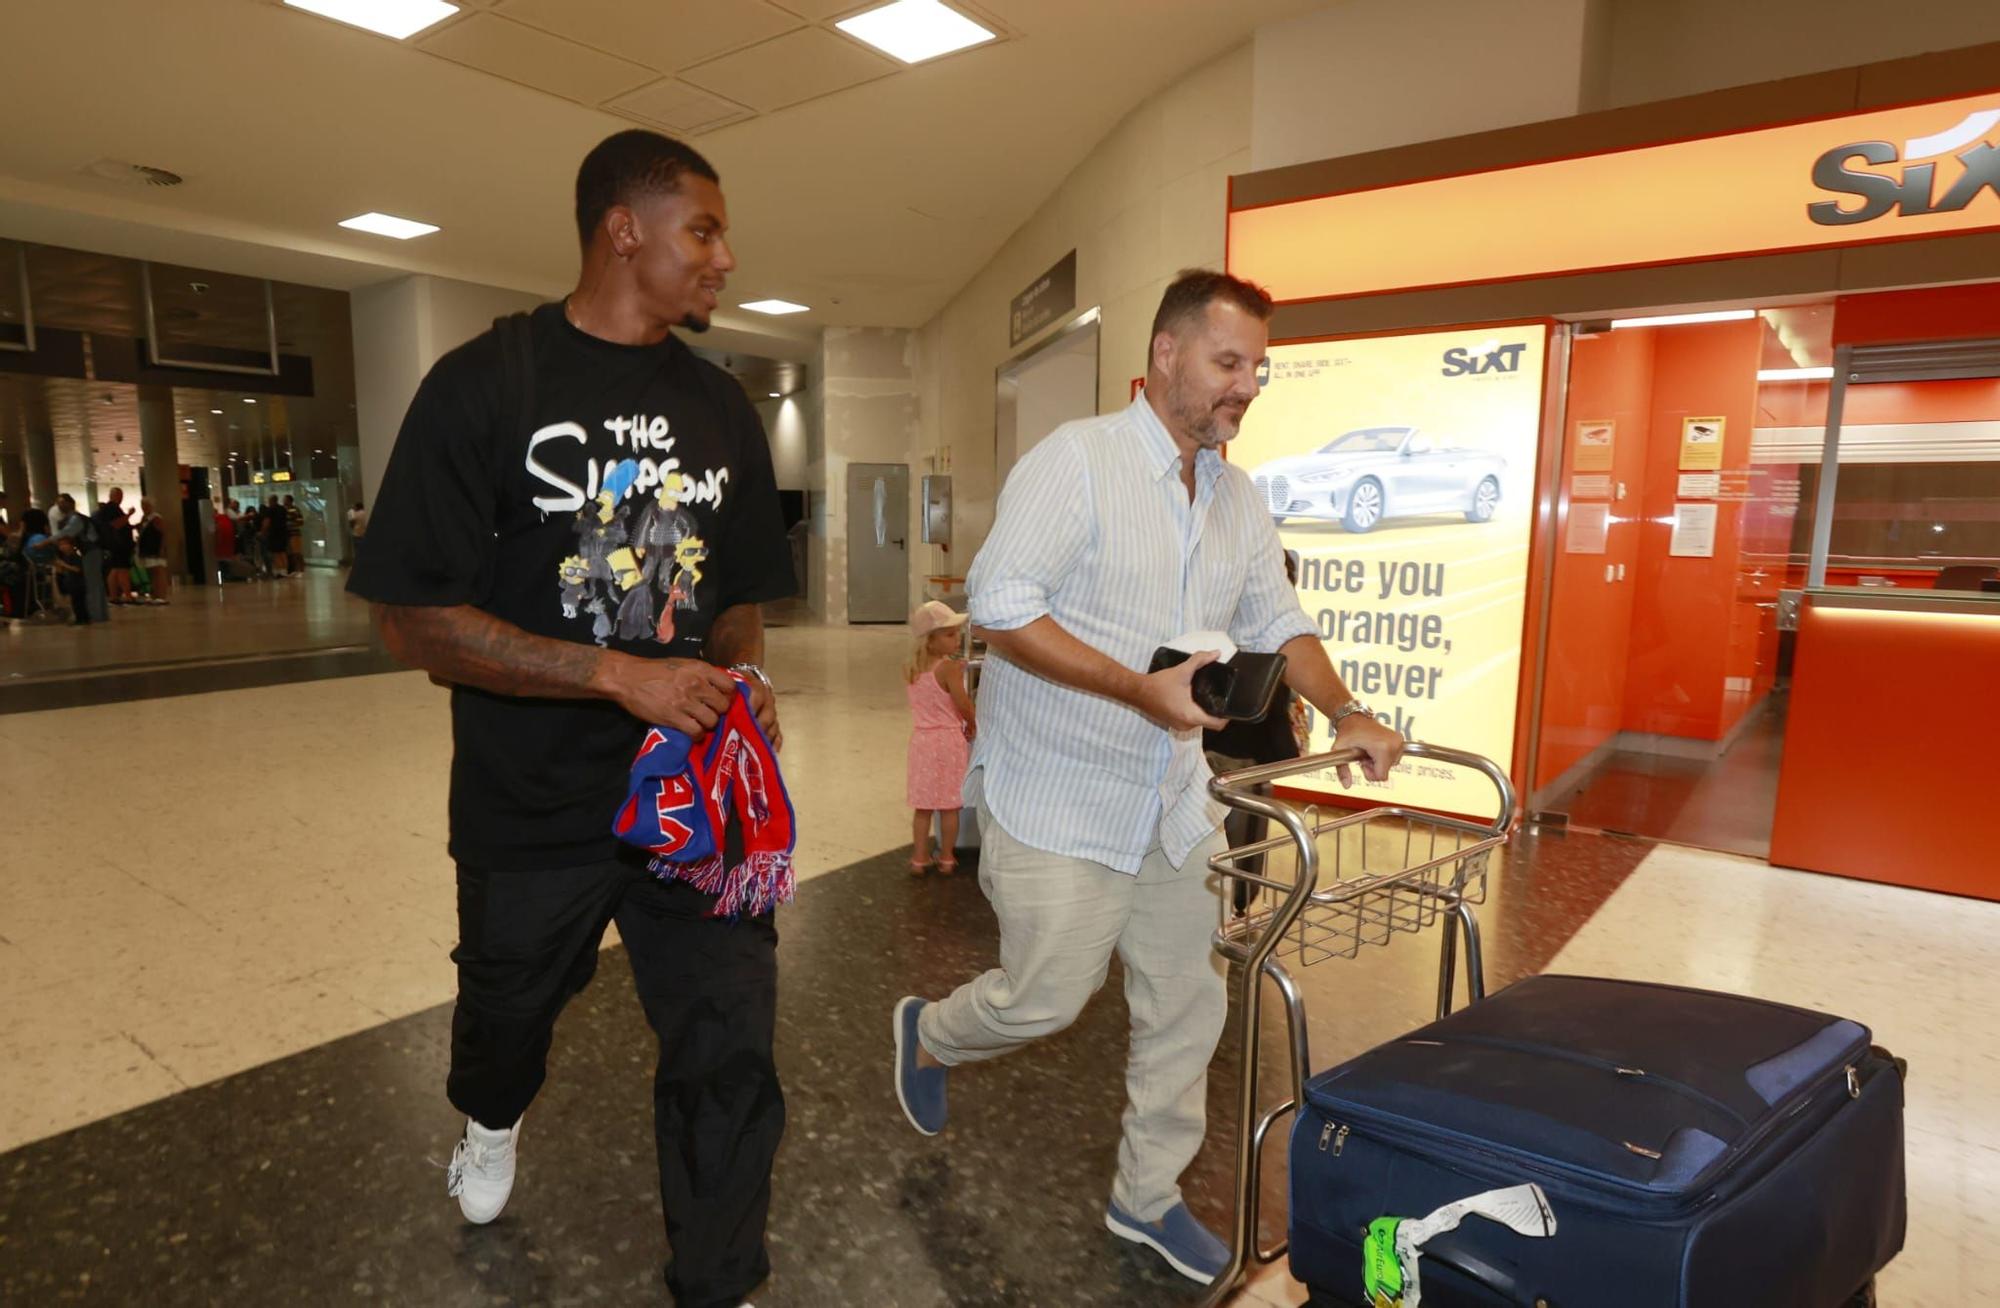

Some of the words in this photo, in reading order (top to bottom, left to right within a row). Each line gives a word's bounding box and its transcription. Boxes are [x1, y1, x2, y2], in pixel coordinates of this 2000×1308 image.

[1378, 561, 1445, 600] you
[1317, 608, 1452, 655] orange,
[1340, 659, 1443, 700] never
